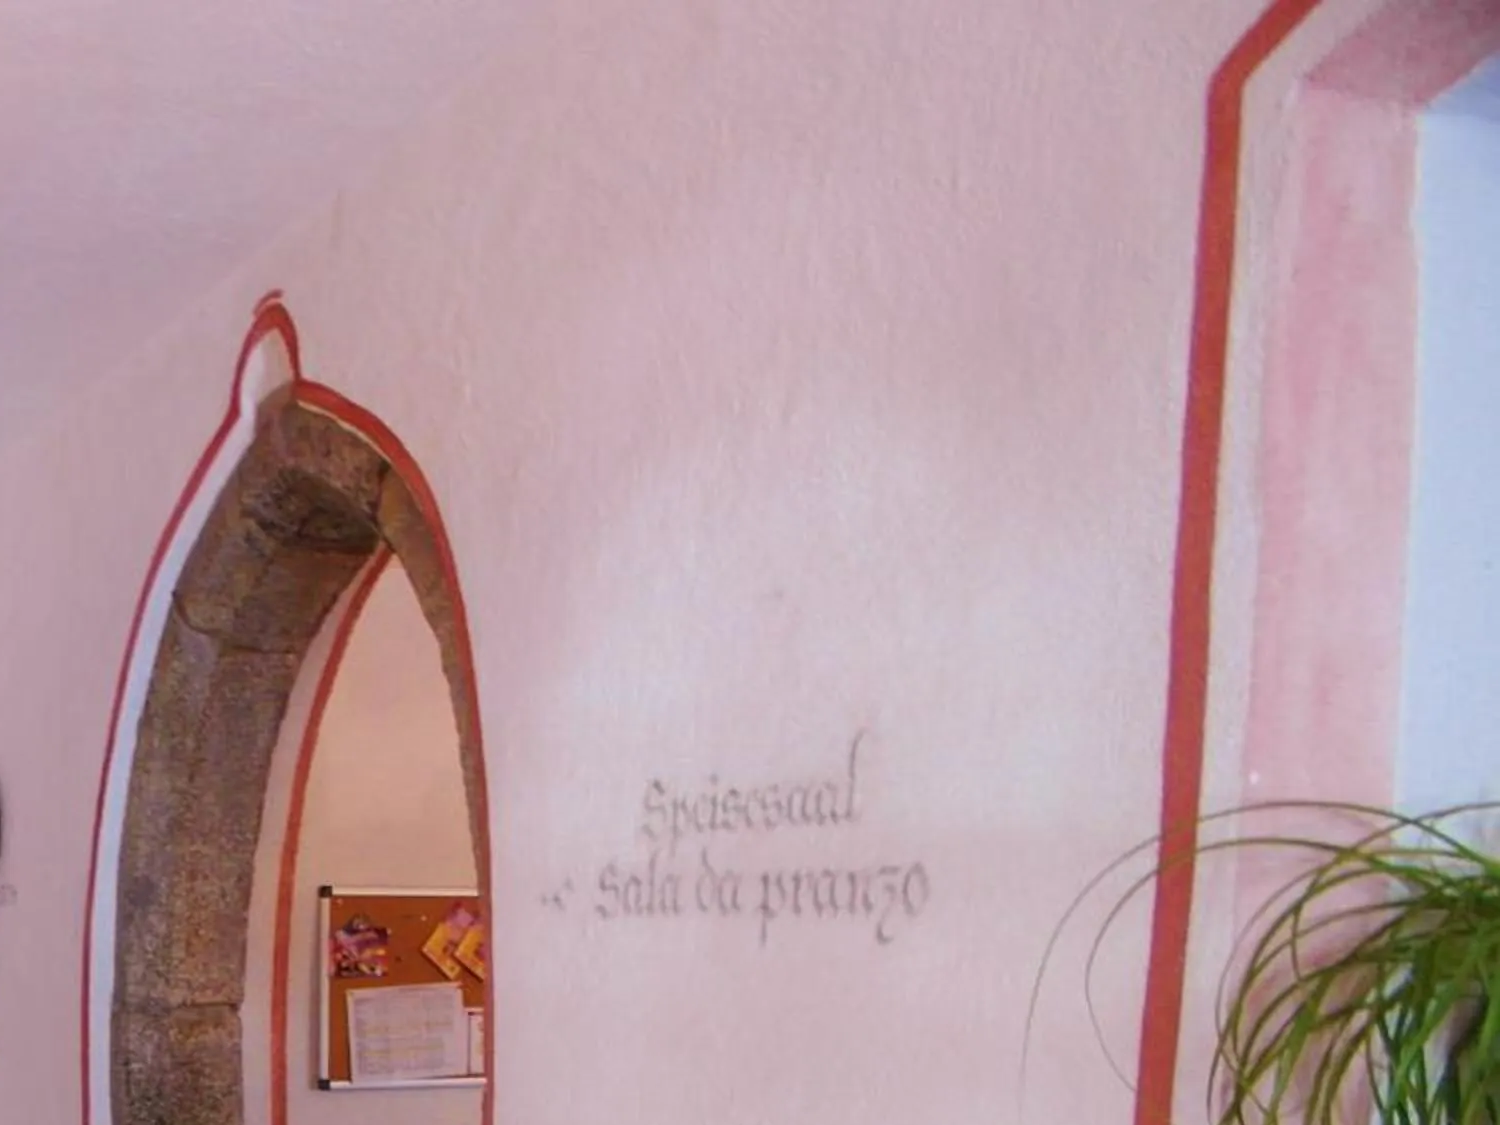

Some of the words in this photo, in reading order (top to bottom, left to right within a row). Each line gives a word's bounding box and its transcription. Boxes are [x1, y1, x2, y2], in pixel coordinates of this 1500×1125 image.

[640, 726, 869, 856] Speisesaal
[594, 848, 682, 921] Sala
[695, 846, 741, 918] da
[759, 861, 932, 947] pranzo
